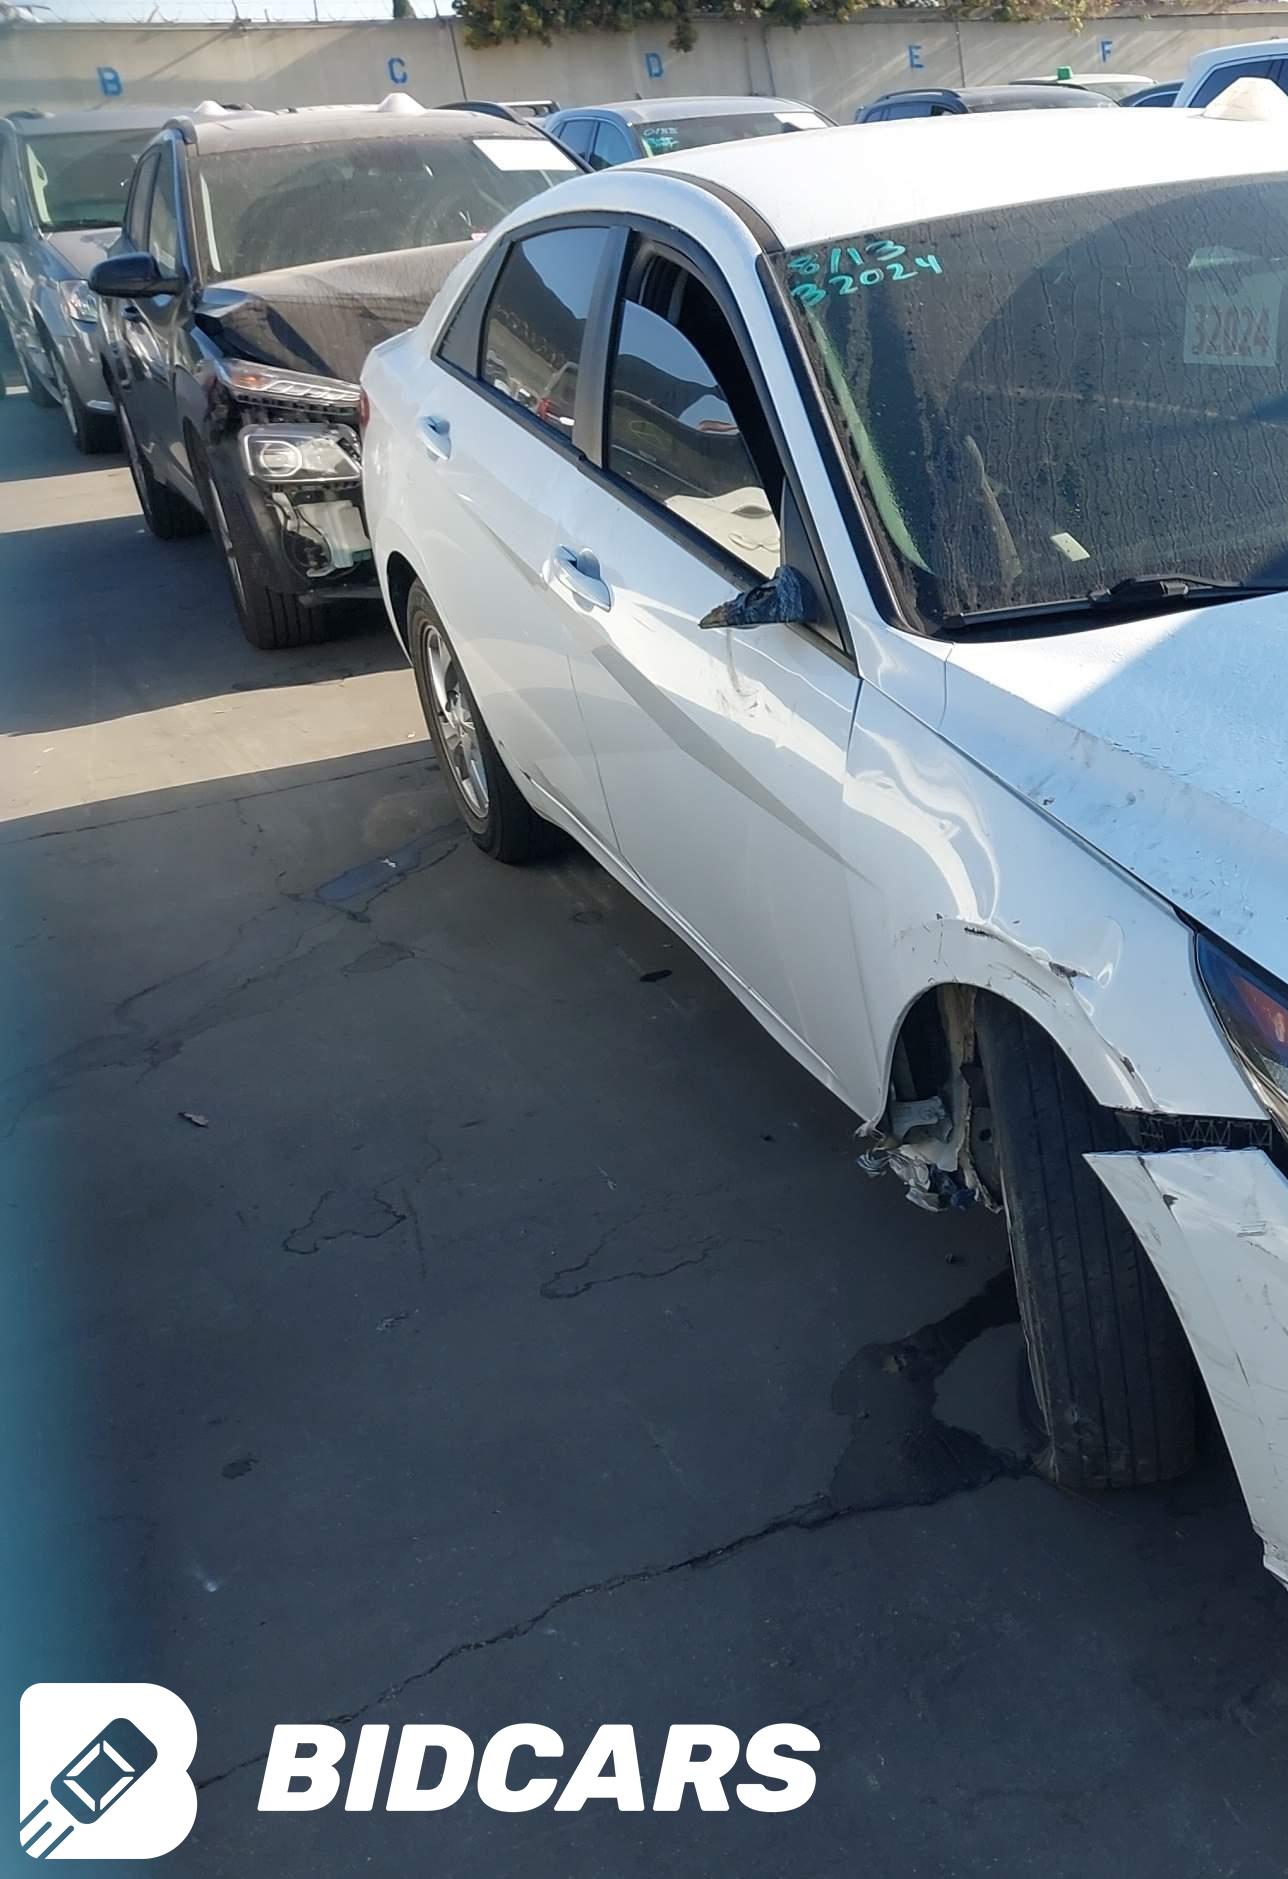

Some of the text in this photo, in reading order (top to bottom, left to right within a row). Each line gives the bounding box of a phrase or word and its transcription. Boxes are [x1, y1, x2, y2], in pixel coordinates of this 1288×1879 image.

[909, 44, 924, 69] E
[1100, 40, 1114, 63] F
[387, 57, 408, 84] C
[645, 52, 663, 78] D
[98, 67, 122, 96] B
[788, 239, 907, 275] 8/13
